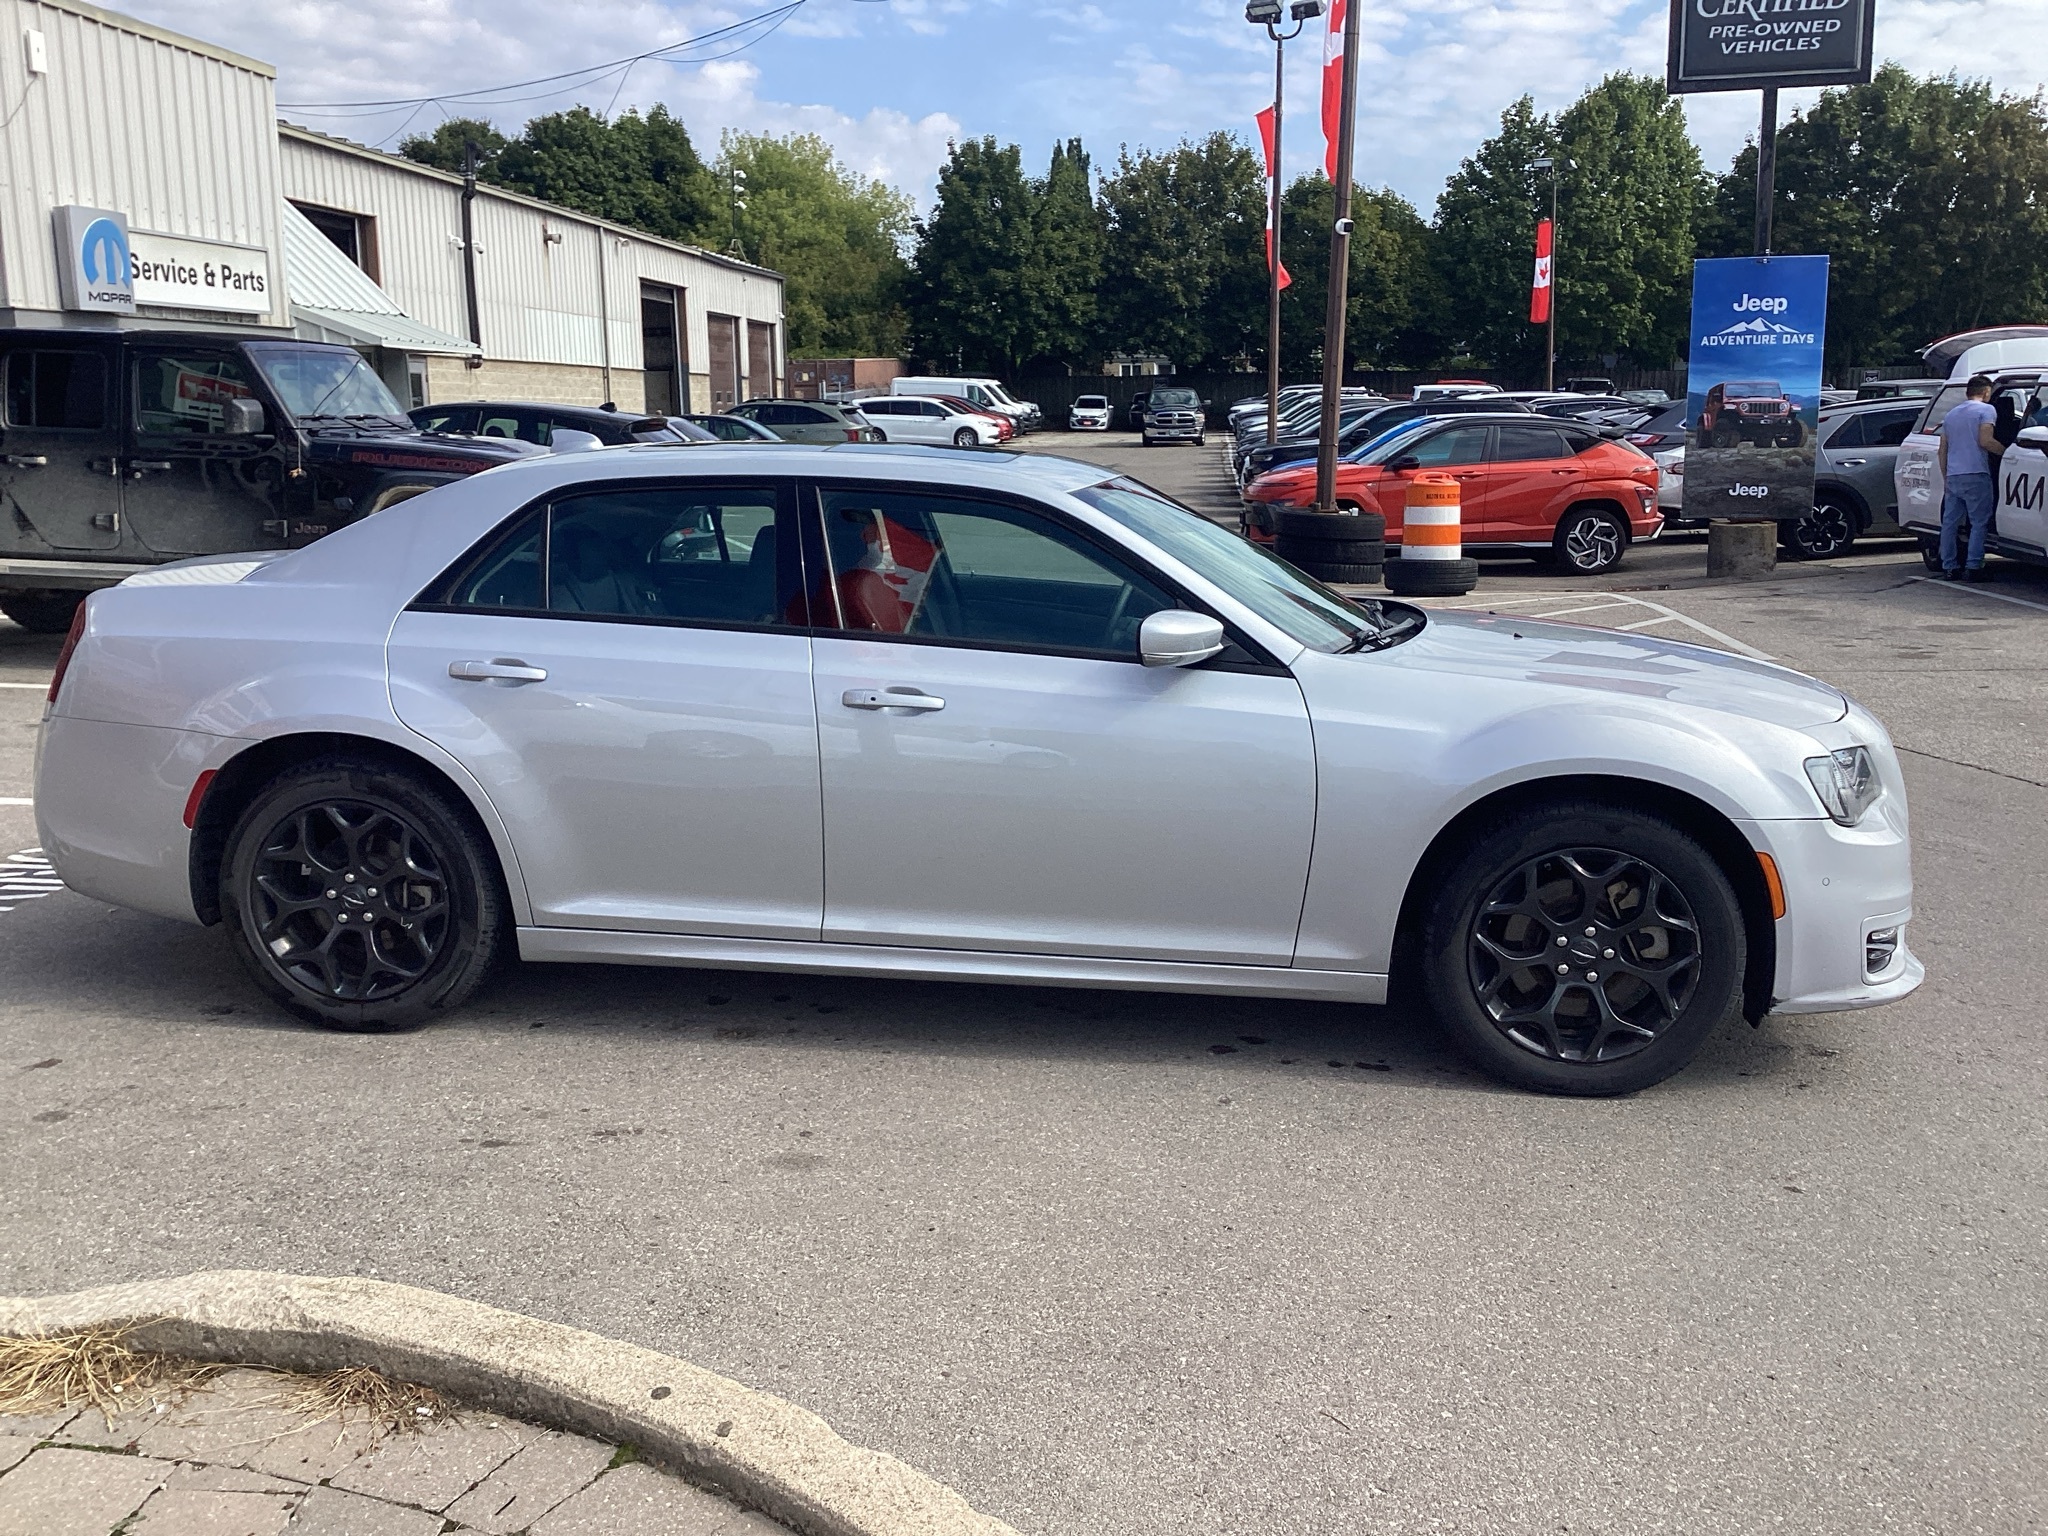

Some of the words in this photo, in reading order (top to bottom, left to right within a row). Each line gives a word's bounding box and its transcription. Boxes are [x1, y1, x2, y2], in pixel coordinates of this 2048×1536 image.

[1709, 19, 1841, 38] PRE-OWNED
[1721, 37, 1821, 54] VEHICLES
[131, 252, 198, 285] Service
[204, 262, 216, 287] &
[221, 264, 265, 292] Parts
[88, 291, 132, 304] MOPAR
[1732, 293, 1788, 314] Jeep
[1700, 334, 1777, 346] ADVENTURE
[1782, 334, 1815, 344] DAYS
[1728, 483, 1768, 498] Jeep
[294, 521, 328, 535] Jeep
